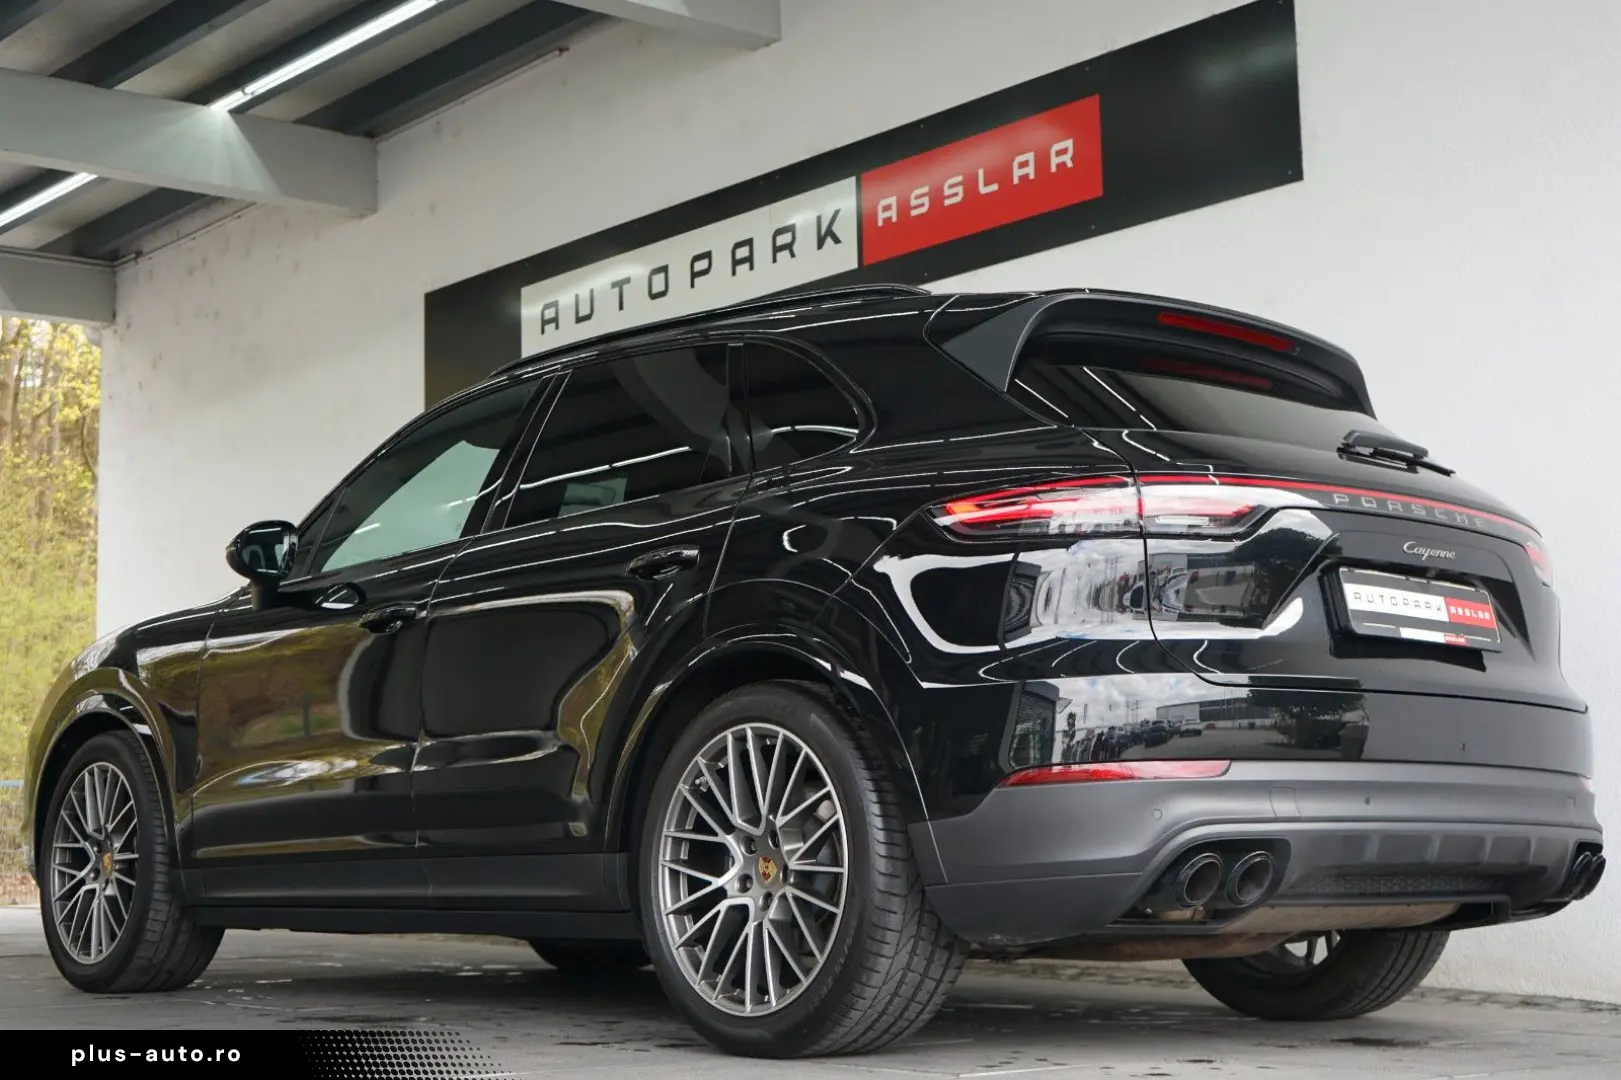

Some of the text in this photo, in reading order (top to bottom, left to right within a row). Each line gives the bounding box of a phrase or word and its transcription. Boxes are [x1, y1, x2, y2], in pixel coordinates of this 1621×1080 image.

[541, 138, 1075, 336] AUTOPARK ASSLAR
[1332, 492, 1486, 528] PORSCHE
[1402, 540, 1458, 561] Cayenne
[1353, 590, 1492, 621] AUTOPARK ASSLAR
